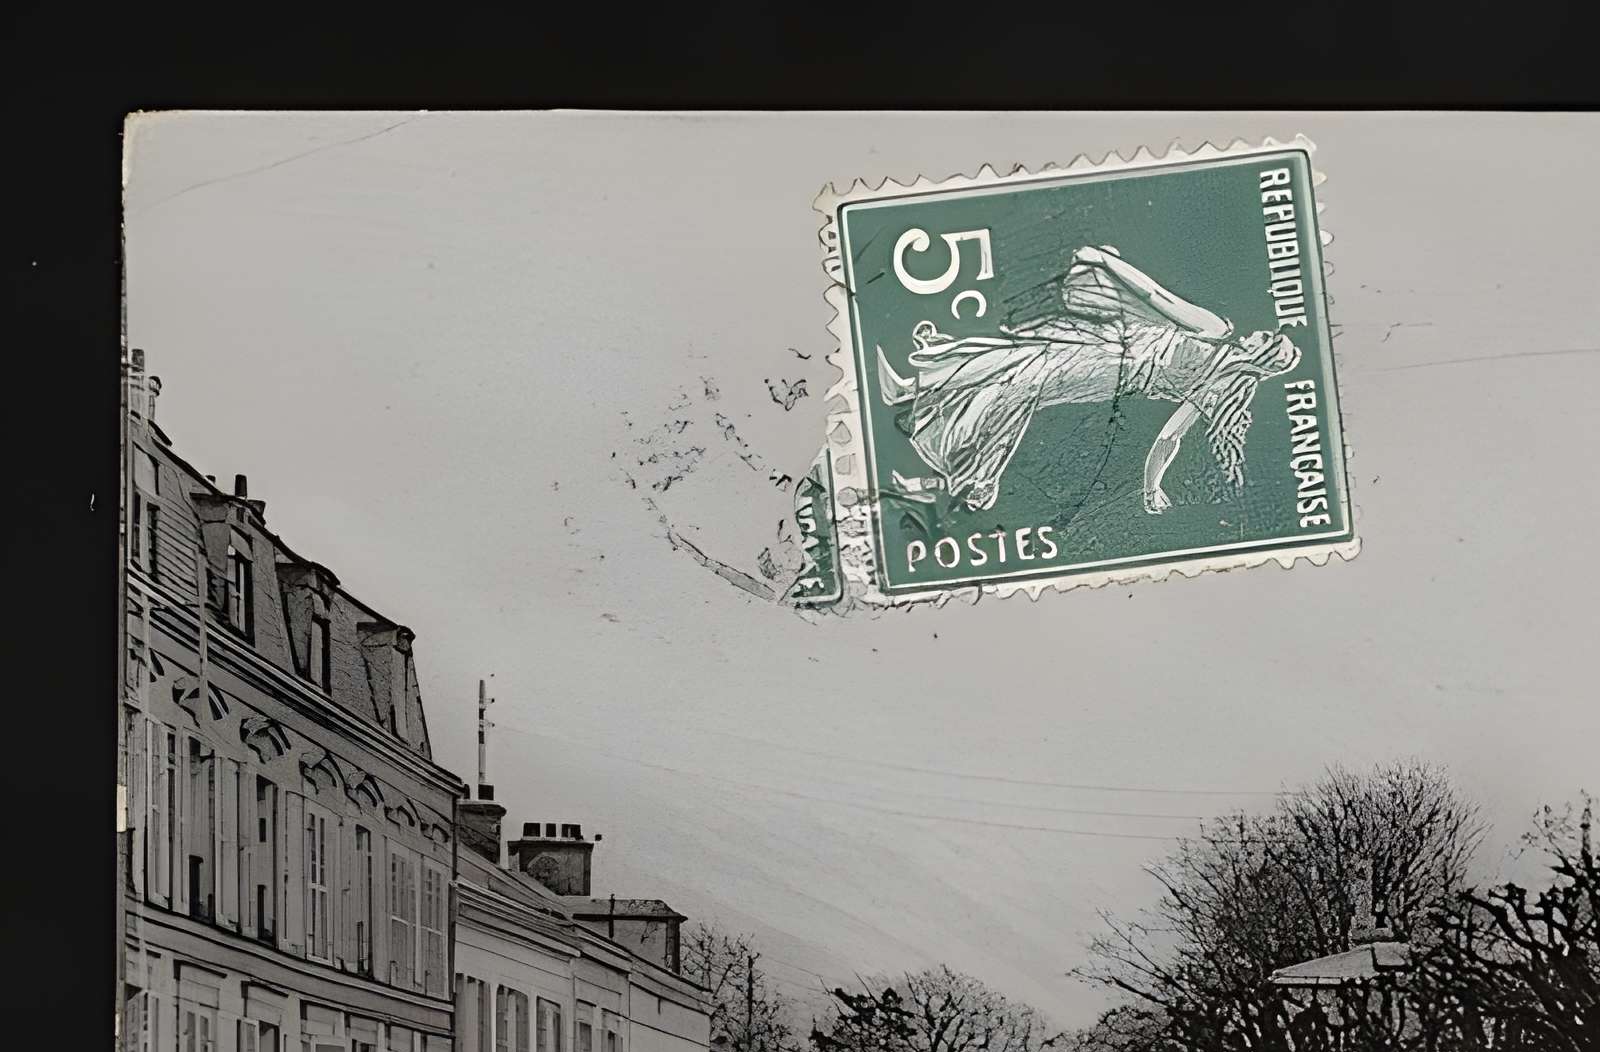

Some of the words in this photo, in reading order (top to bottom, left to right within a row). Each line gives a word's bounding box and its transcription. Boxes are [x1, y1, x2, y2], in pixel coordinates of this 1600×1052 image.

[1259, 168, 1308, 328] REPUBLIQUE
[1284, 379, 1331, 528] FRANÇAISE
[906, 526, 1058, 572] POSTES
